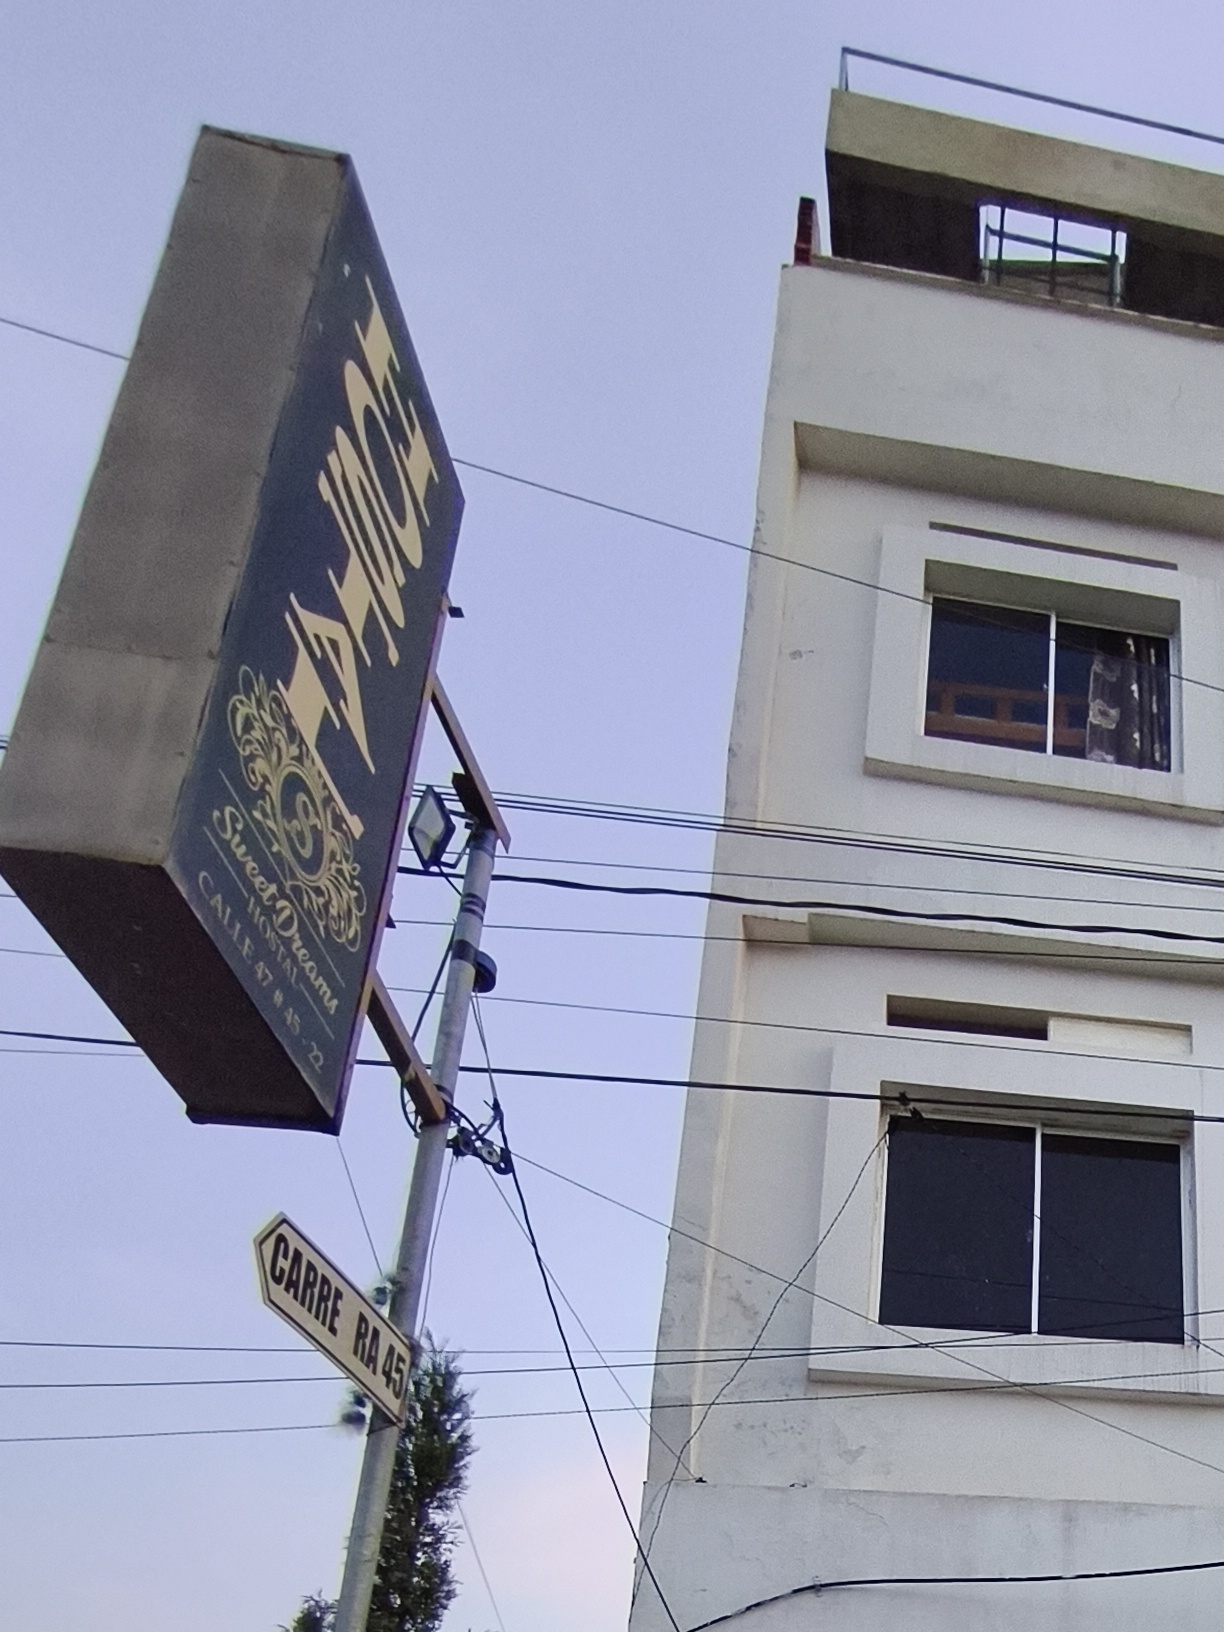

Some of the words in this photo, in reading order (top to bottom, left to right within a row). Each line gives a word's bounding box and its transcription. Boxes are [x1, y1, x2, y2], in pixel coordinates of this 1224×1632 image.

[277, 274, 439, 840] HOSTAL
[199, 871, 254, 965] CALLE
[255, 961, 273, 987] 47
[284, 1007, 300, 1035] 45
[308, 1041, 324, 1074] 22
[213, 805, 279, 906] Sweet
[273, 900, 338, 1015] Dreams
[247, 896, 298, 988] HOSTAL
[270, 1233, 343, 1337] CARRE
[353, 1311, 380, 1376] RA
[382, 1344, 406, 1400] 45
